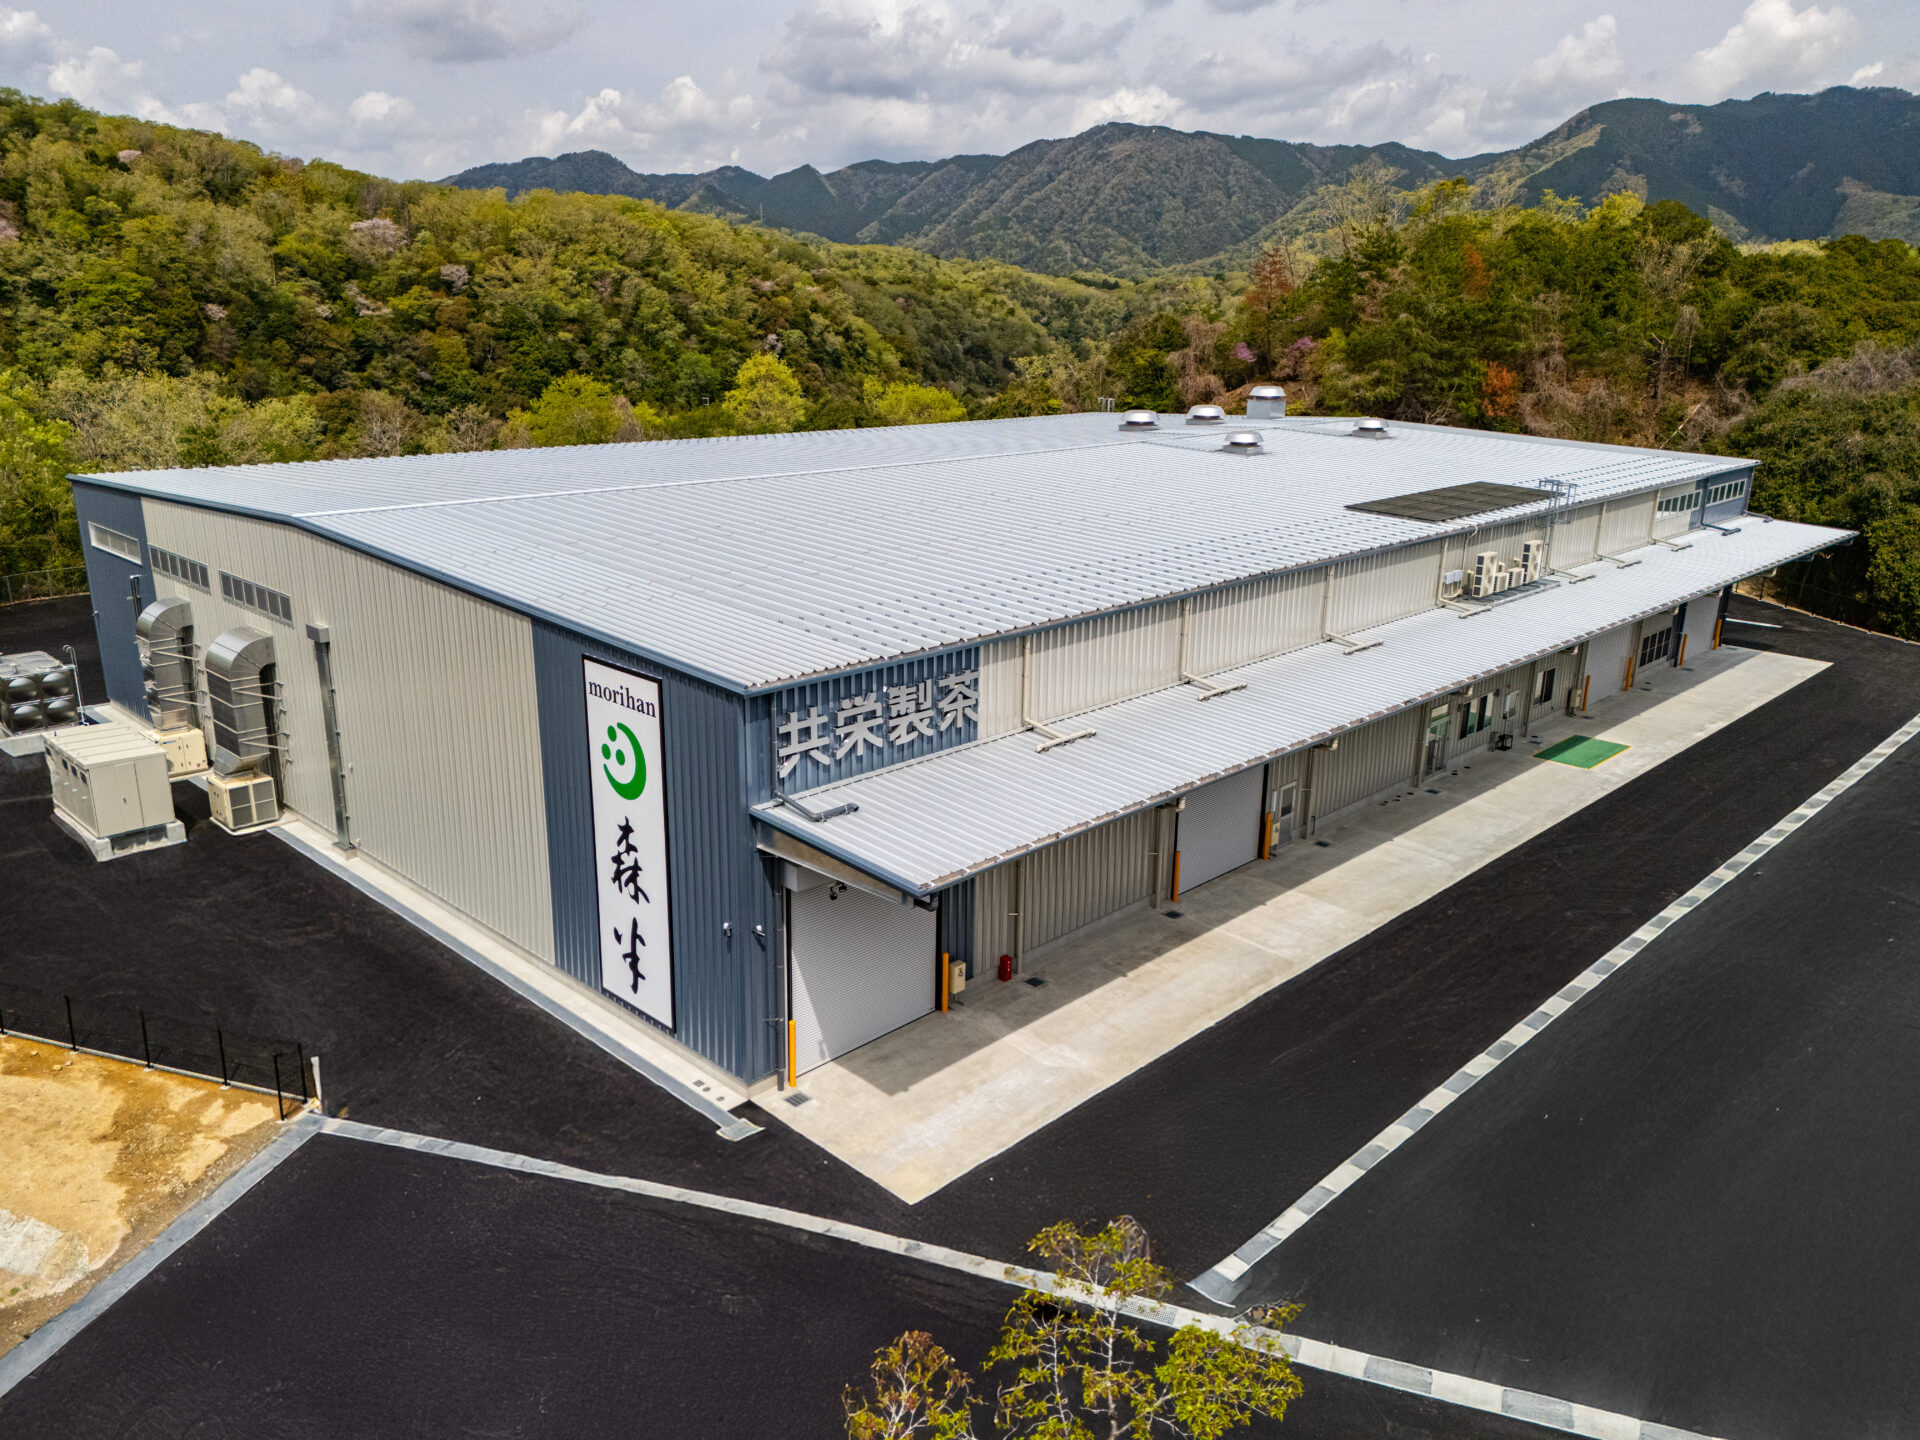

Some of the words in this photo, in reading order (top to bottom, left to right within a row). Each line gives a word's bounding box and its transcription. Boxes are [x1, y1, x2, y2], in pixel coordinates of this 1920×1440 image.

[588, 681, 656, 718] morihan
[778, 670, 979, 778] 共栄製茶
